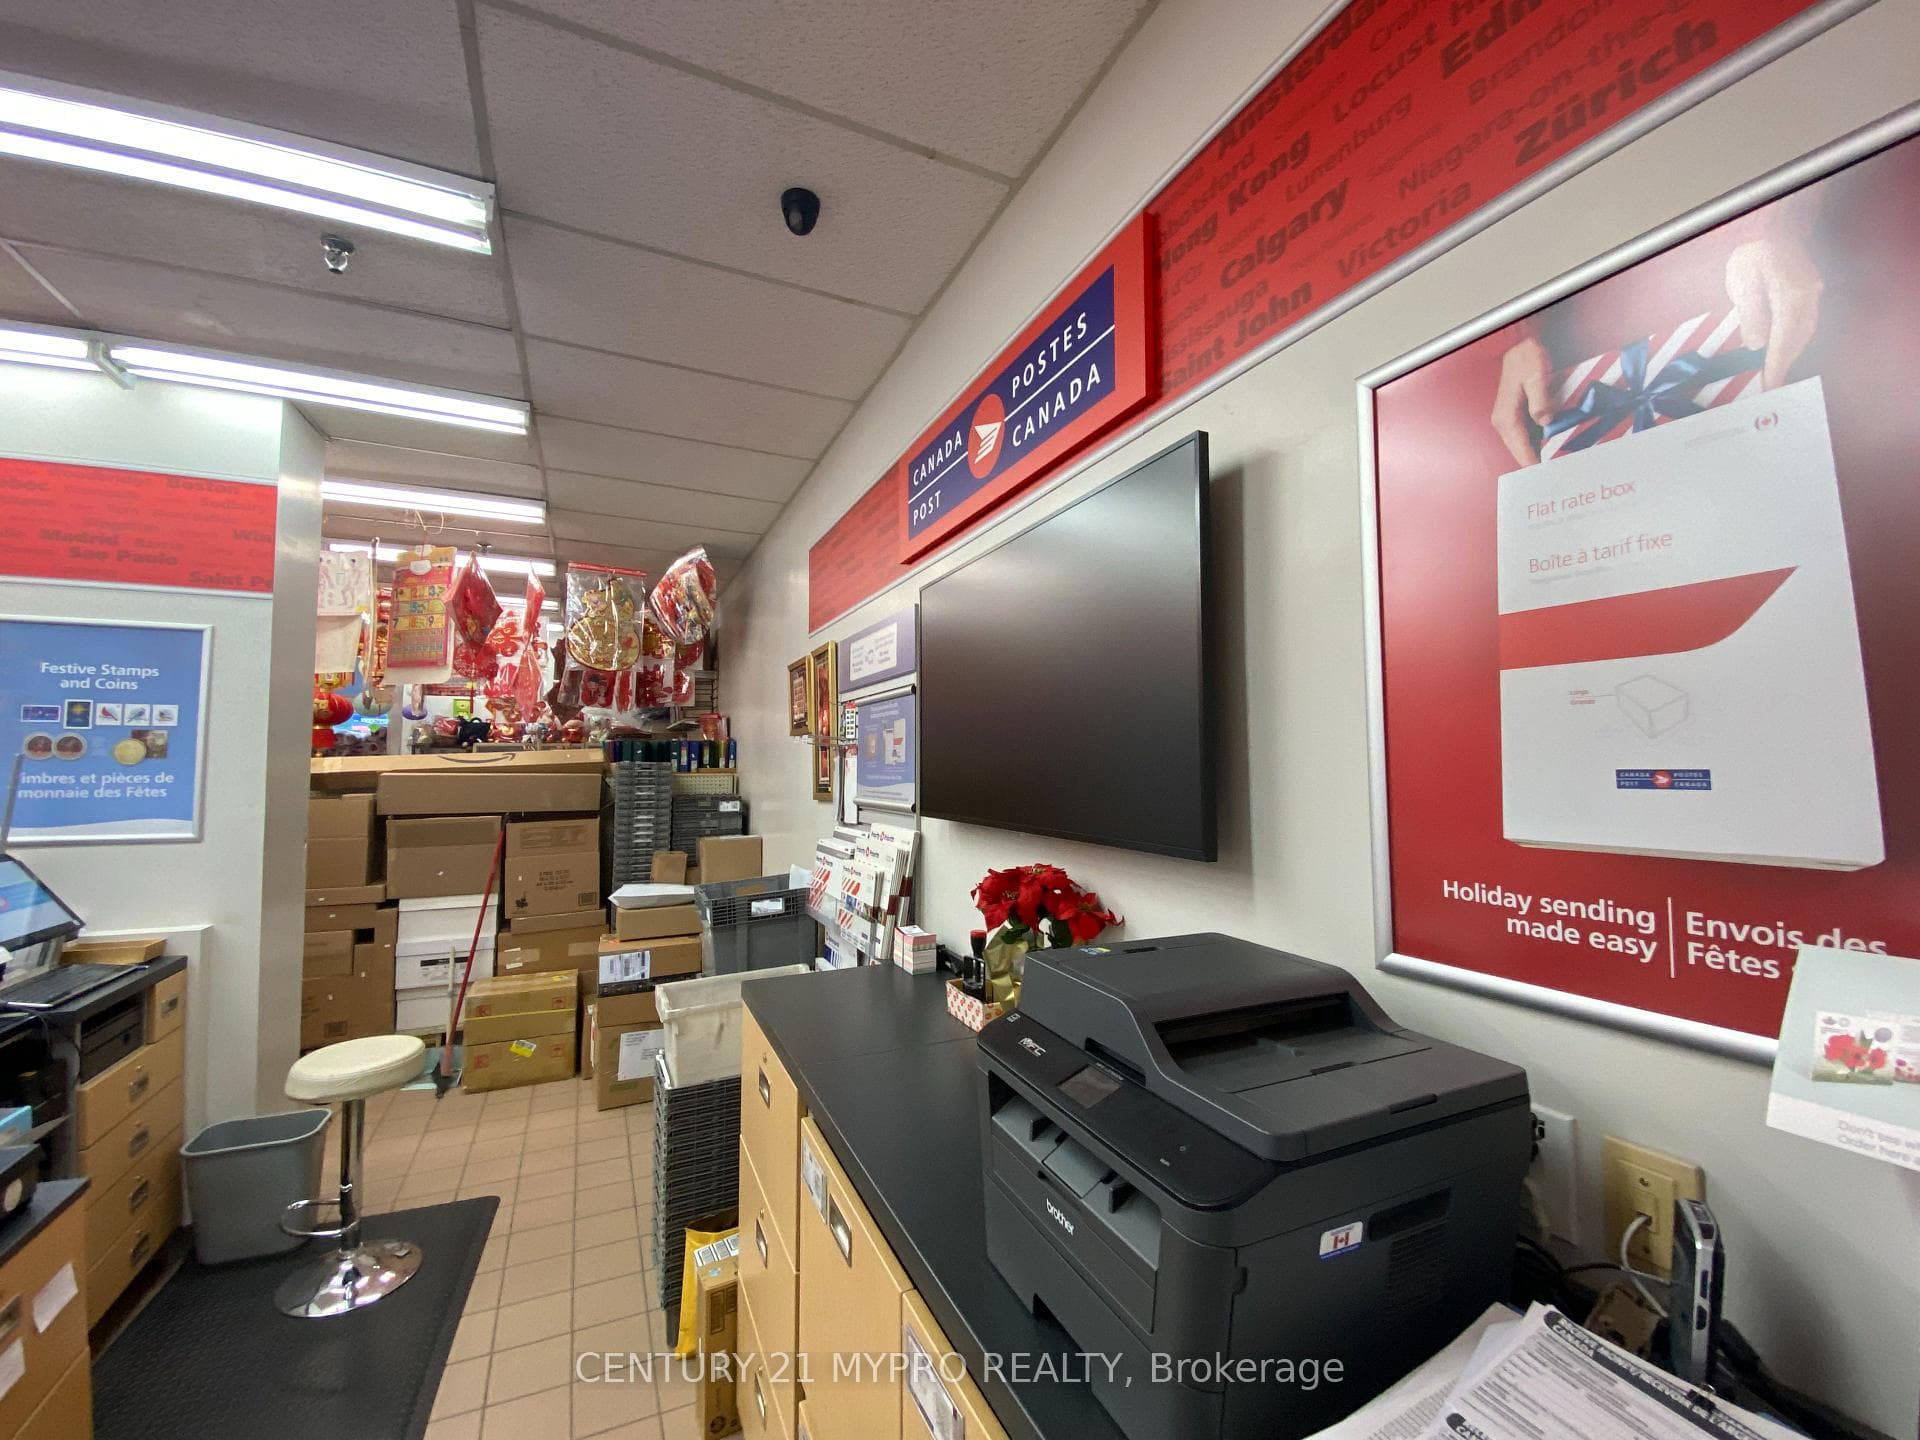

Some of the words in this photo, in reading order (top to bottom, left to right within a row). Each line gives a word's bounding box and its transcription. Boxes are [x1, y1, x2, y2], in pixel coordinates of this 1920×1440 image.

[1513, 20, 1719, 167] Zürich
[1227, 131, 1312, 217] Kong
[1220, 177, 1347, 289] Calgary
[1337, 181, 1471, 279] Victoria
[1234, 281, 1312, 348] John
[1012, 312, 1087, 398] POSTES
[1012, 363, 1101, 447] CANADA
[913, 430, 962, 486] CANADA
[913, 491, 941, 525] POST
[1527, 499, 1555, 521] Flat
[1561, 490, 1596, 512] rate
[1600, 480, 1637, 502] box
[117, 549, 178, 566] Paulo
[1528, 551, 1573, 574] Boîte
[1591, 535, 1633, 561] tarif
[1637, 531, 1673, 552] fixe
[188, 571, 243, 586] Saint
[40, 661, 97, 675] Festive
[101, 663, 160, 679] Stamps
[60, 677, 90, 689] and
[95, 677, 138, 690] Coins
[17, 787, 90, 799] monnaie
[94, 786, 121, 799] des
[126, 785, 167, 798] Fêtes
[80, 773, 97, 784] et
[101, 771, 152, 786] pièces
[155, 771, 174, 784] de
[1443, 880, 1532, 915] Holiday
[1540, 897, 1655, 934] sending
[1507, 917, 1580, 944] made
[1589, 931, 1658, 963] easy
[1686, 911, 1803, 950] Envois
[1687, 941, 1780, 979] Fêtes
[1018, 1037, 1046, 1056] MFC
[1046, 1198, 1075, 1236] brother
